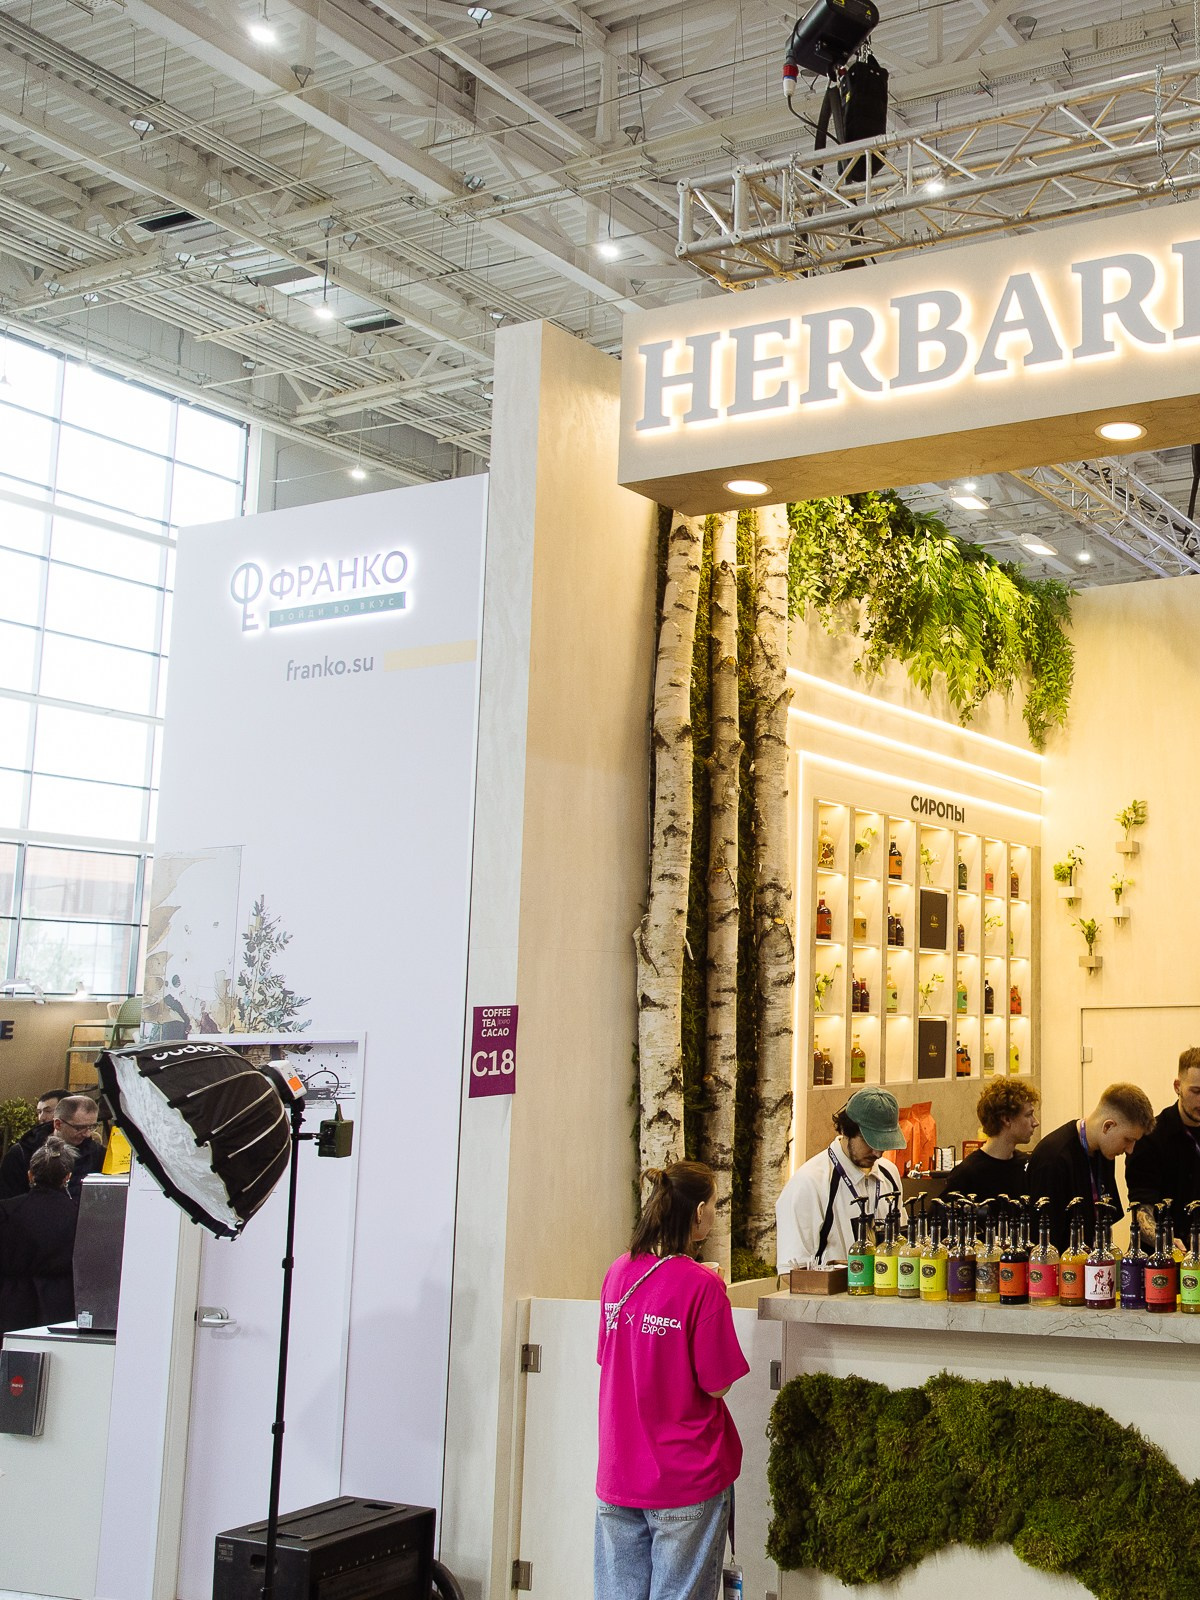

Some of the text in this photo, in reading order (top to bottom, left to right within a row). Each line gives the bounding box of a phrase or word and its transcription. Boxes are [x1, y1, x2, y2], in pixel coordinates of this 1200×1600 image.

[269, 551, 408, 600] ФРАНКО
[279, 597, 395, 622] ВОЙДИ ВО ВКУС
[286, 655, 374, 681] franko.su
[911, 795, 965, 823] СИРОПЫ
[482, 1008, 511, 1018] COFFEE
[482, 1018, 497, 1028] TEA
[481, 1027, 510, 1037] CACAO
[472, 1049, 515, 1077] C18
[641, 1323, 666, 1336] EXPO
[643, 1313, 681, 1330] HORECA
